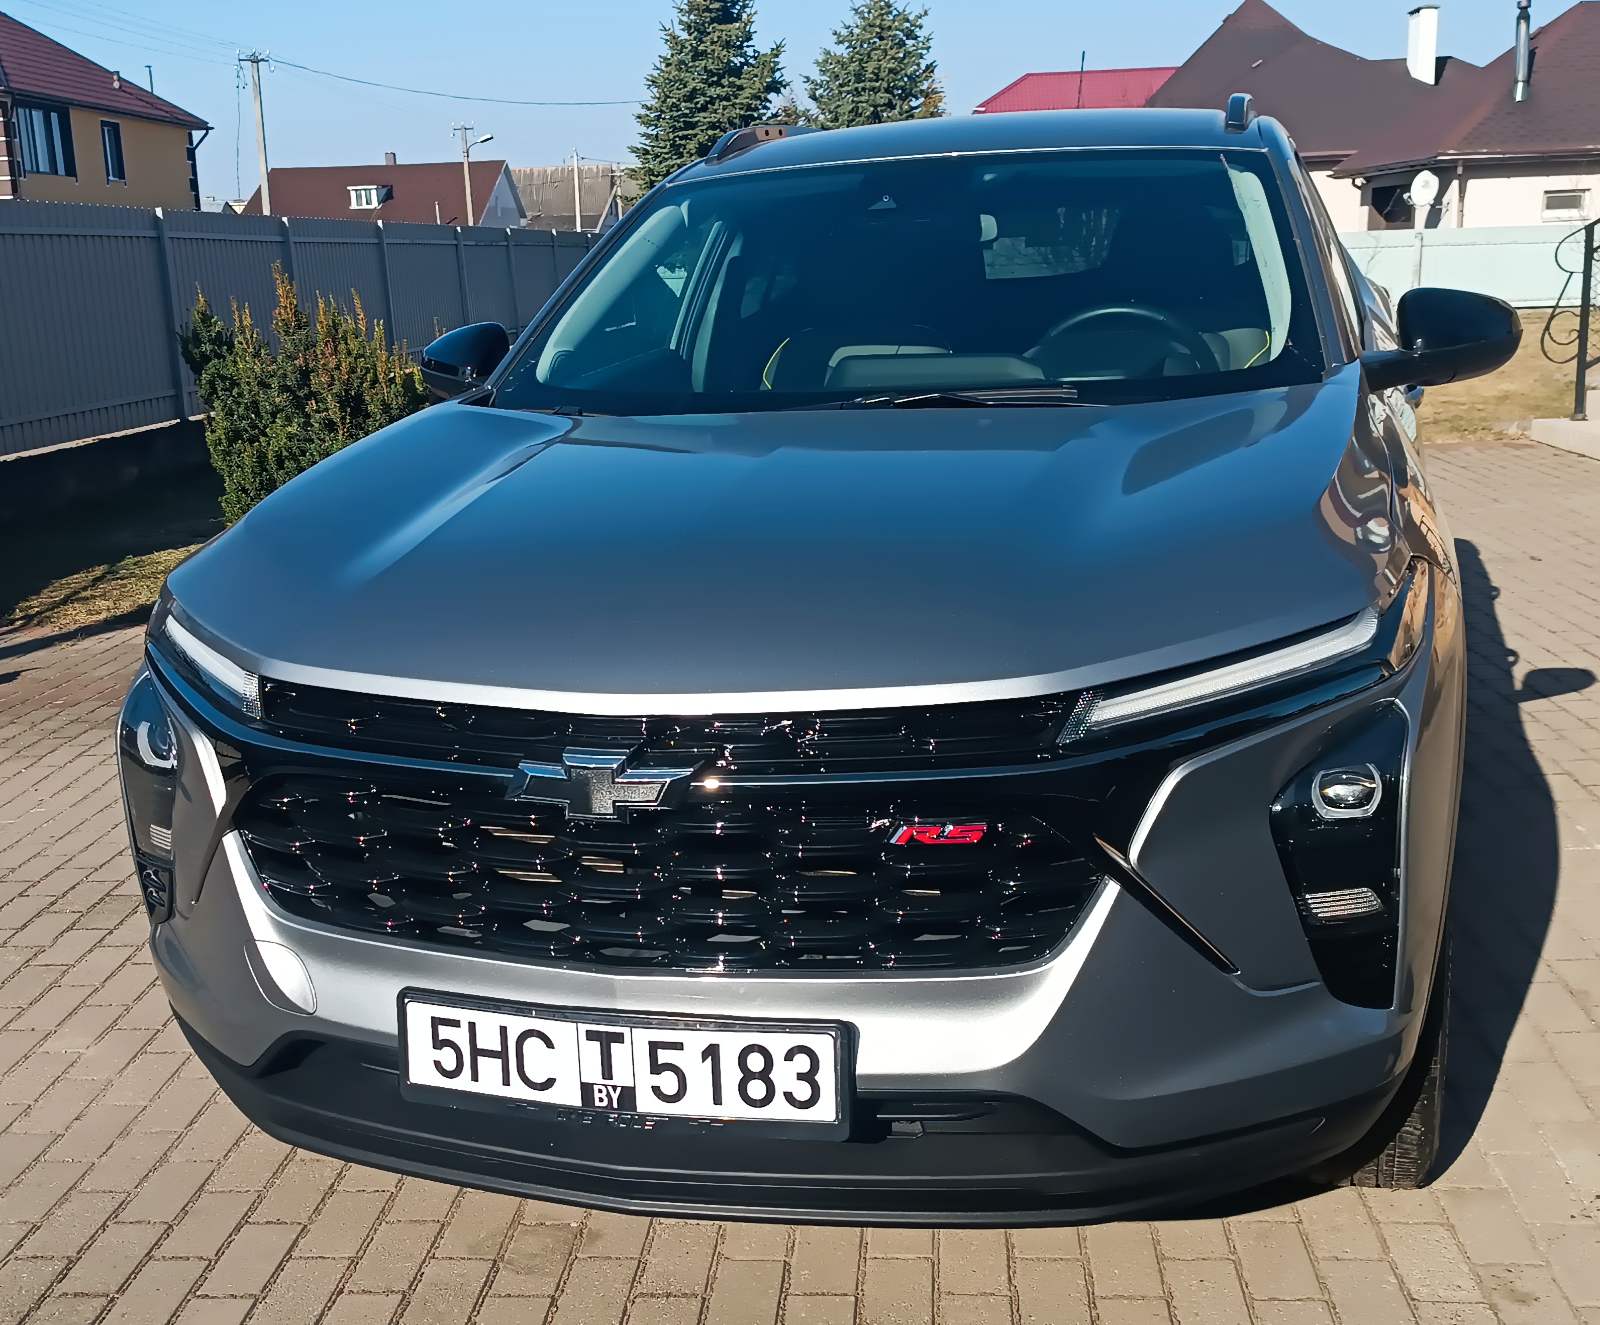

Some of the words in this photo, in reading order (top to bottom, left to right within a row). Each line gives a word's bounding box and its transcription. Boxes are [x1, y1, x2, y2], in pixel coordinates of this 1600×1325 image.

[889, 824, 988, 845] RS
[431, 1016, 557, 1091] 5HC
[585, 1030, 625, 1081] T
[648, 1041, 821, 1110] 5183
[593, 1085, 622, 1107] BY
